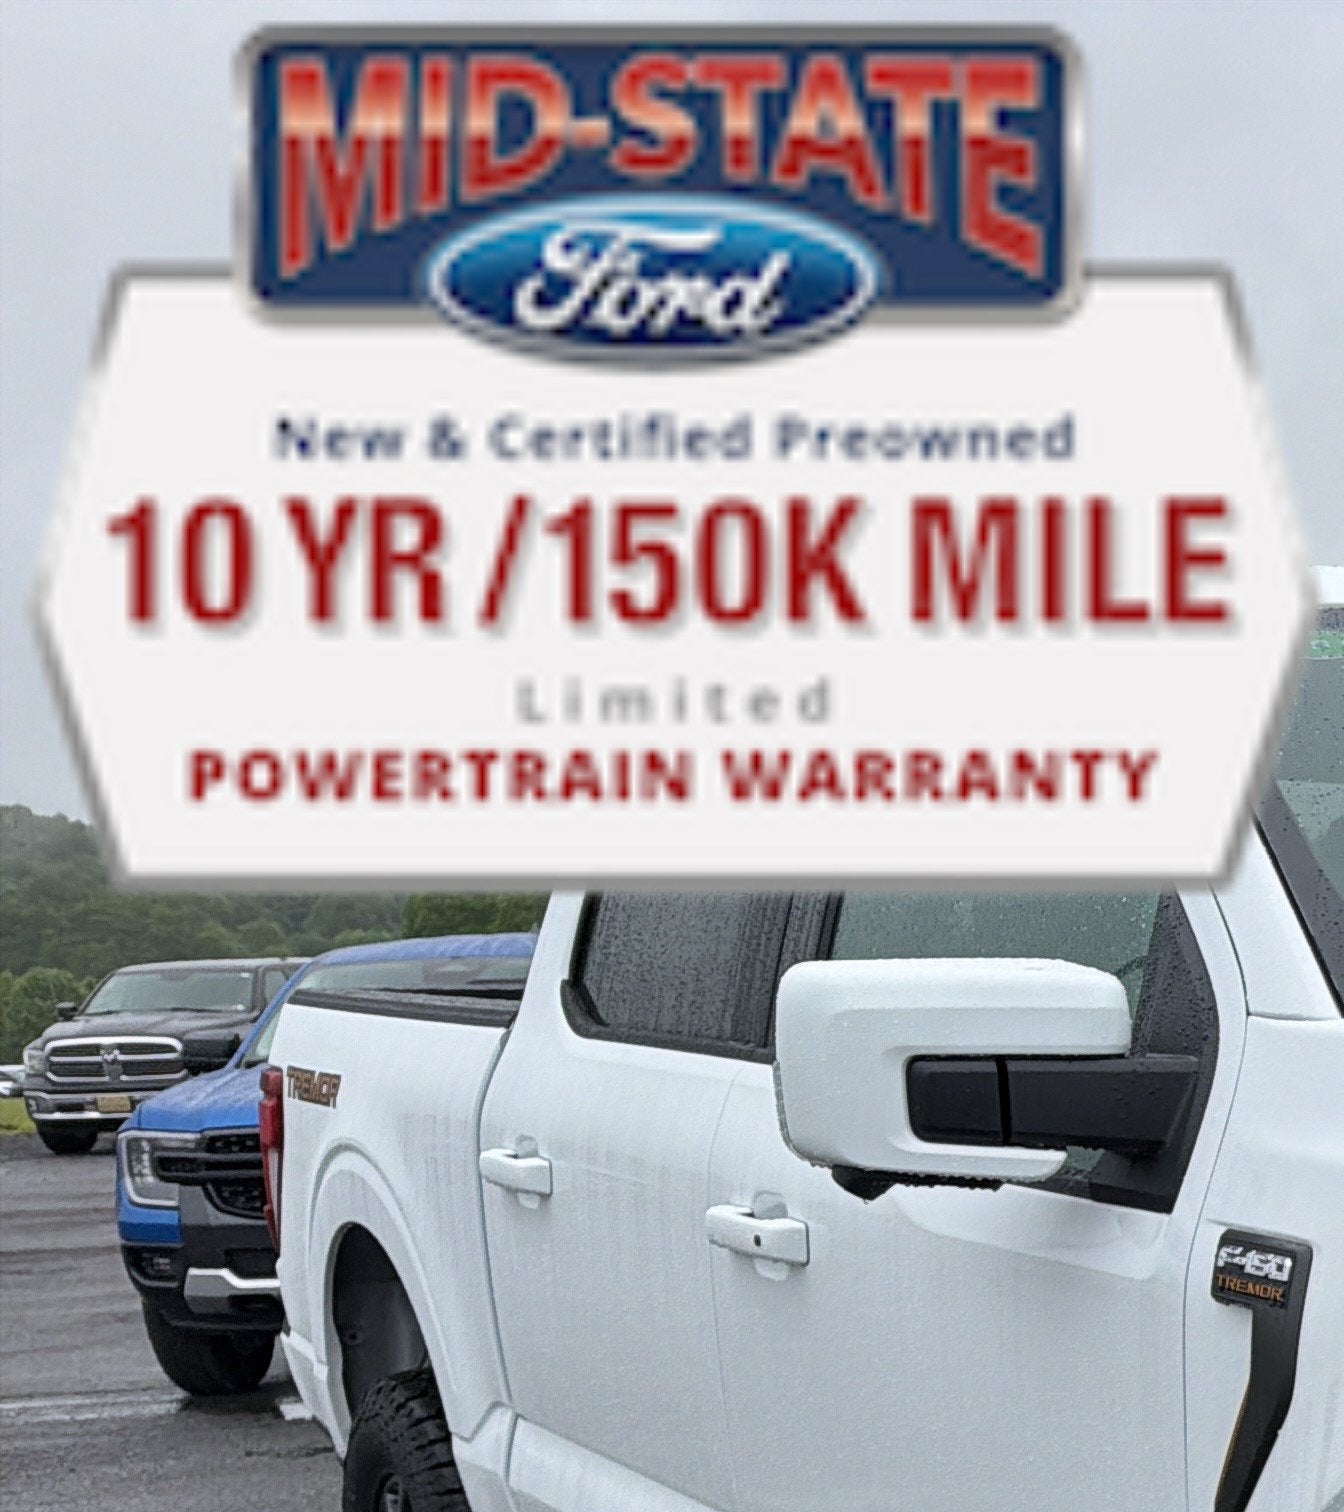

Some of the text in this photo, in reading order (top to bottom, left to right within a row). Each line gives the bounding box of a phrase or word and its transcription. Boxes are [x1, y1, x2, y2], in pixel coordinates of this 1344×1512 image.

[286, 1065, 342, 1110] TREMOR
[1217, 1245, 1293, 1282] F-150
[1217, 1274, 1285, 1301] TREMOR
